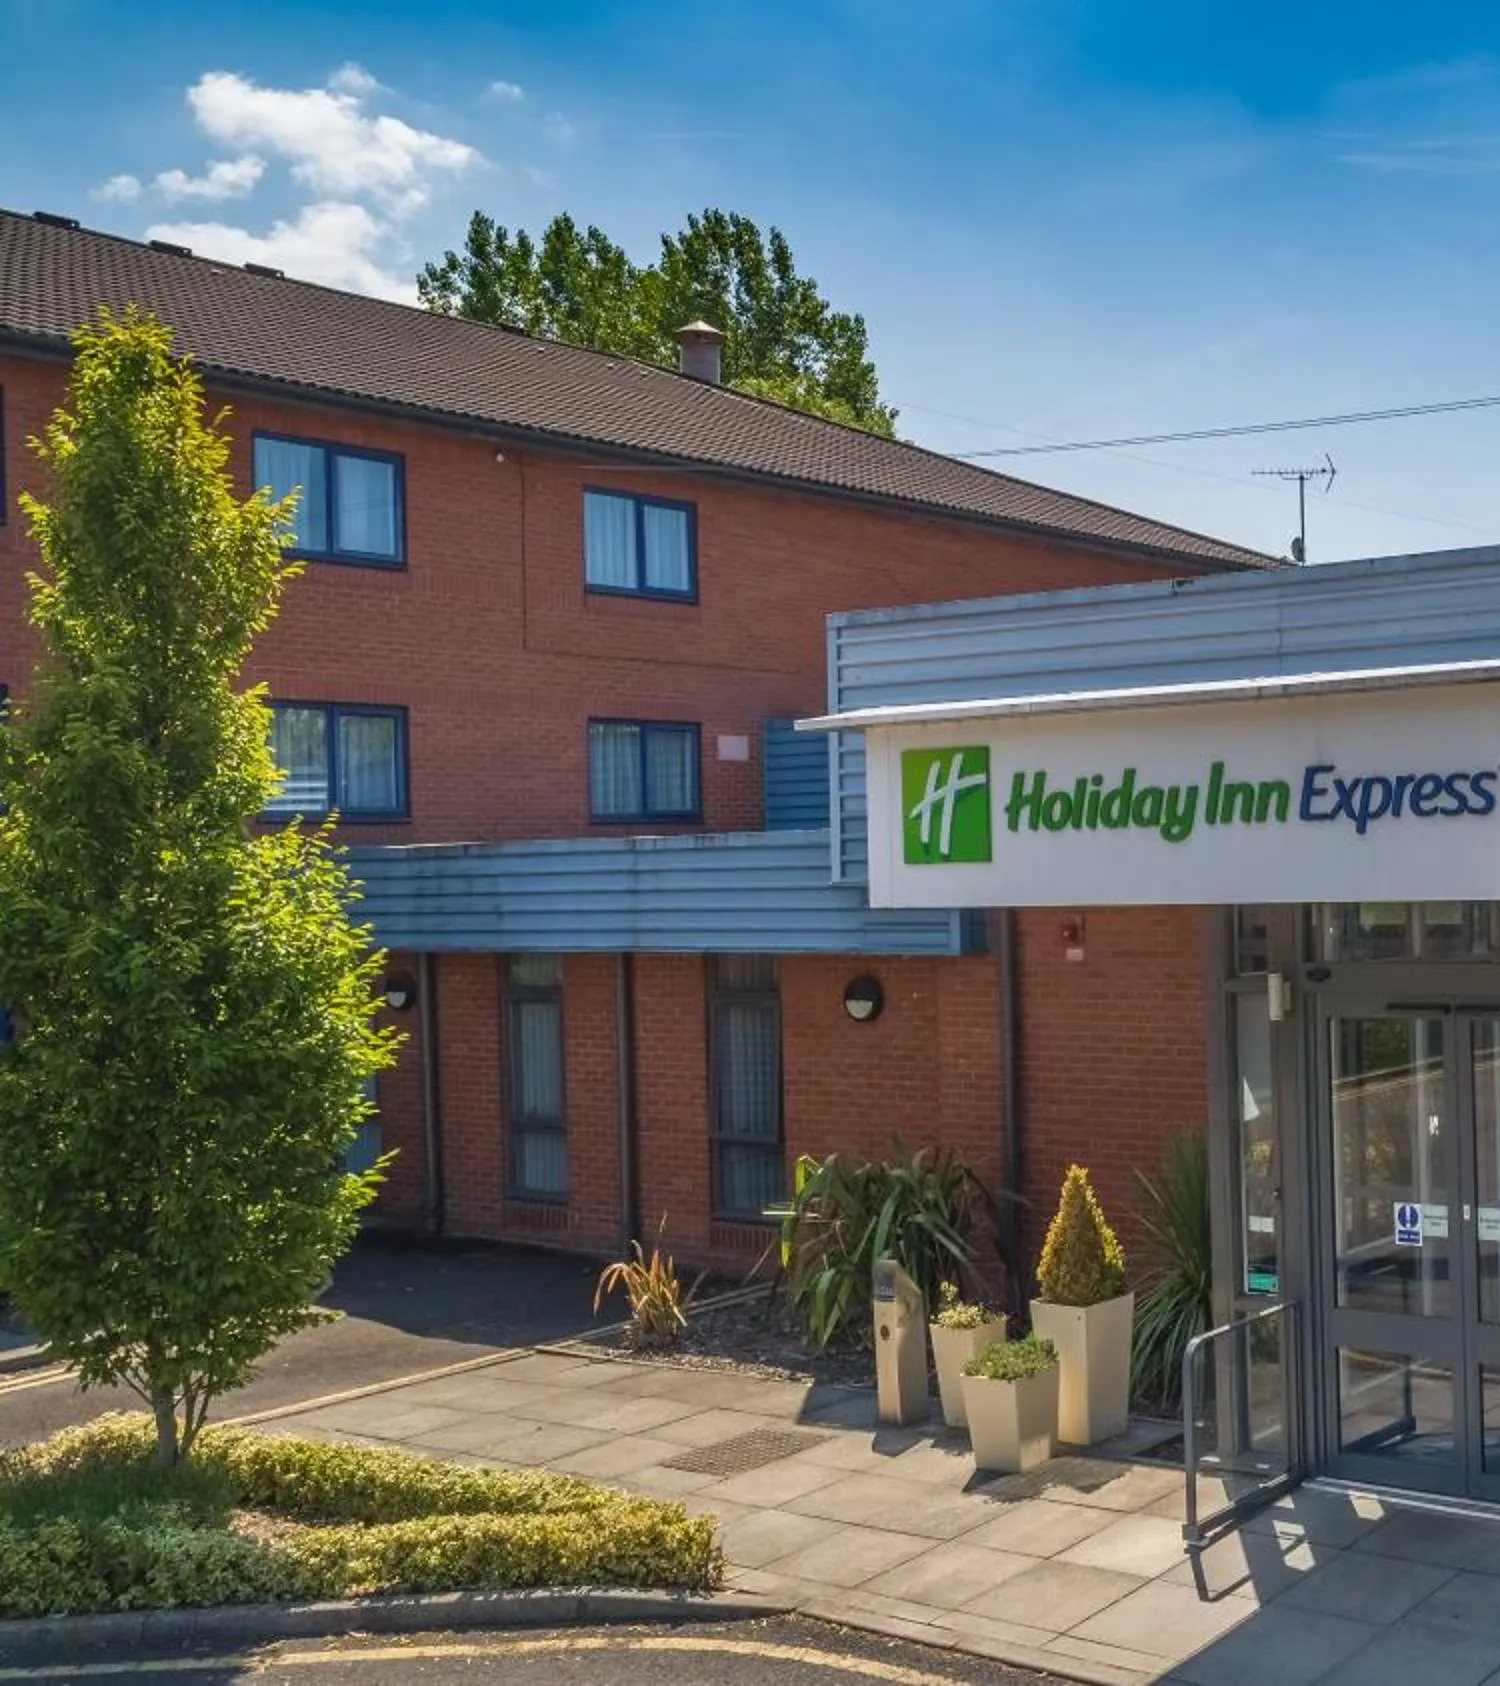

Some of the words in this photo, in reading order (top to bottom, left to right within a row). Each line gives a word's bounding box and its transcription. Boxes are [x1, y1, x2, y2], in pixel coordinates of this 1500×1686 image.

[1005, 767, 1199, 842] Holiday
[1205, 761, 1290, 825] Inn
[1300, 764, 1498, 834] Express
